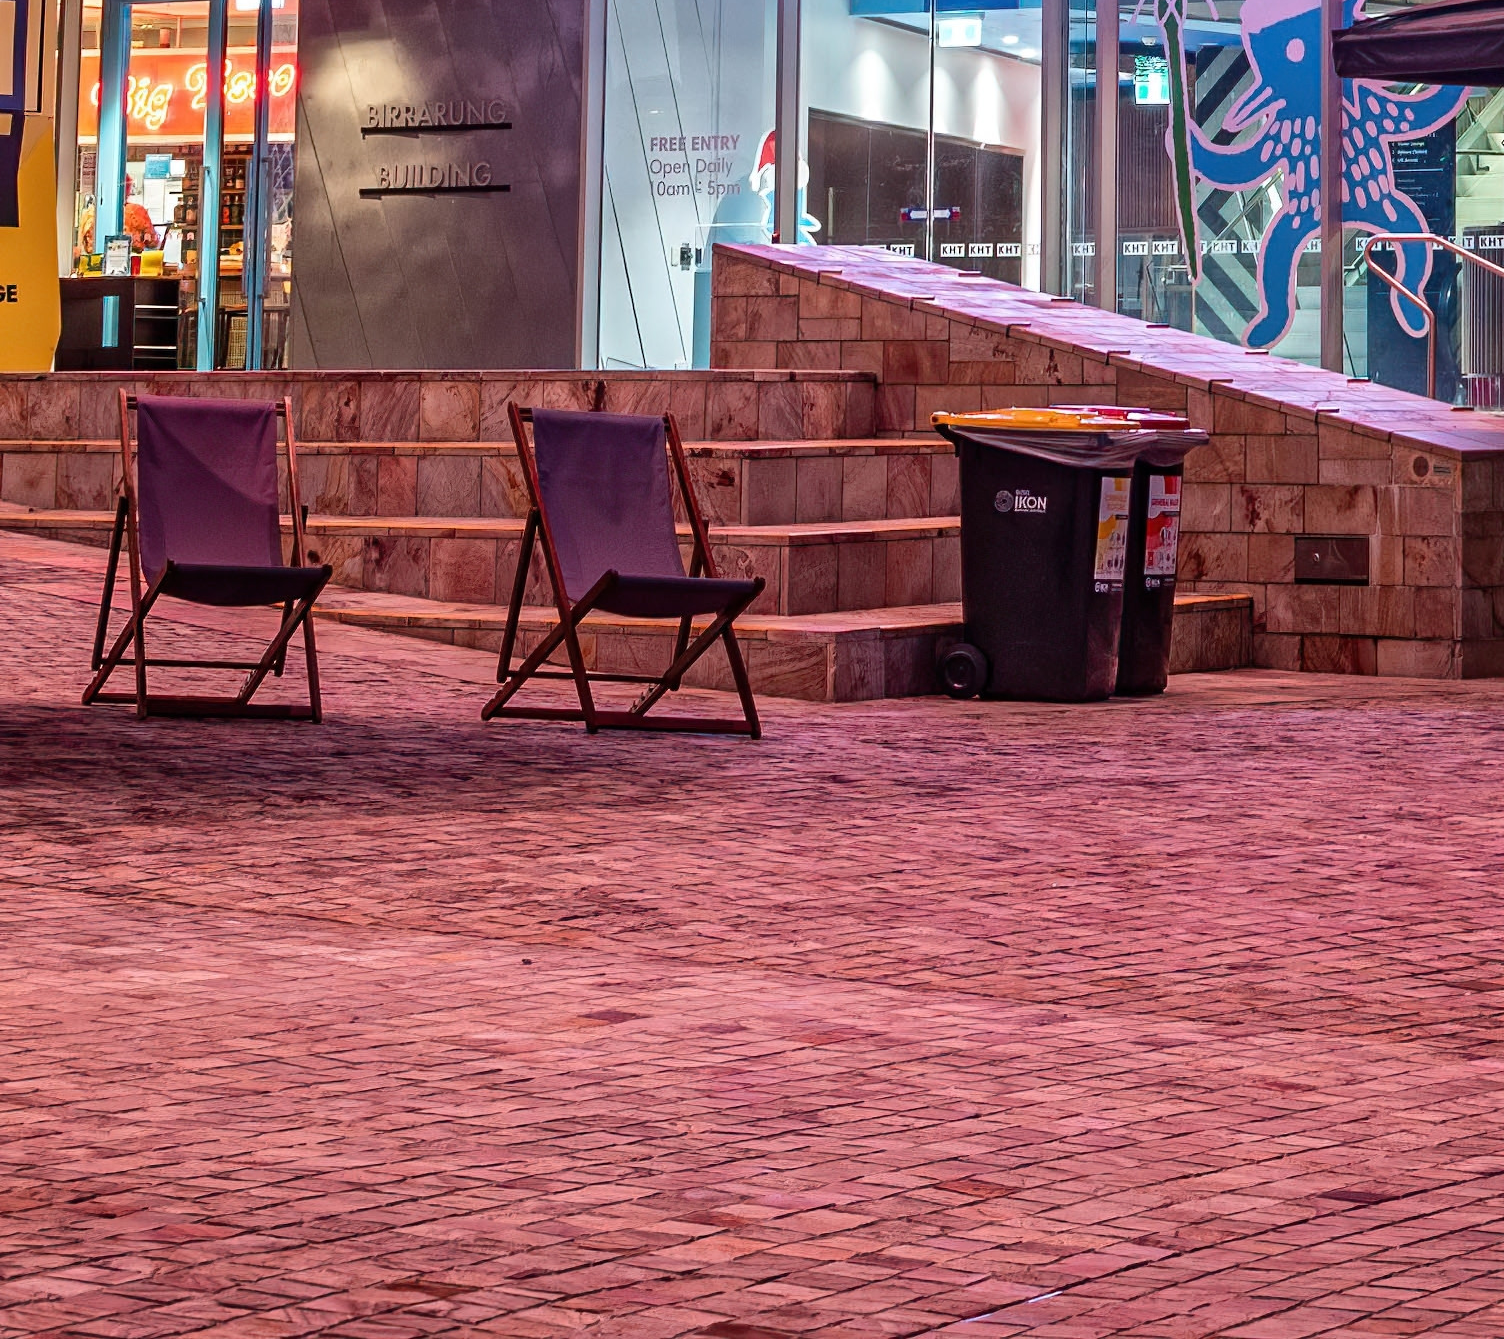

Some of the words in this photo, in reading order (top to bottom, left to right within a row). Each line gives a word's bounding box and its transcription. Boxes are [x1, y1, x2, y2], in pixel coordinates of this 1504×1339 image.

[367, 101, 506, 128] BIRRARUNG
[650, 137, 686, 152] FREE
[691, 134, 740, 151] ENTRY
[379, 161, 492, 189] BUILDING
[696, 157, 733, 178] Daily
[707, 180, 741, 200] 5pm
[942, 245, 964, 255] KHT
[970, 245, 992, 255] KHT
[998, 245, 1020, 255] KHT
[1074, 245, 1096, 254] KHT
[1124, 244, 1146, 253] KHT
[1153, 243, 1176, 253] KHT
[1480, 237, 1504, 248] KHT
[1014, 495, 1047, 510] IKON
